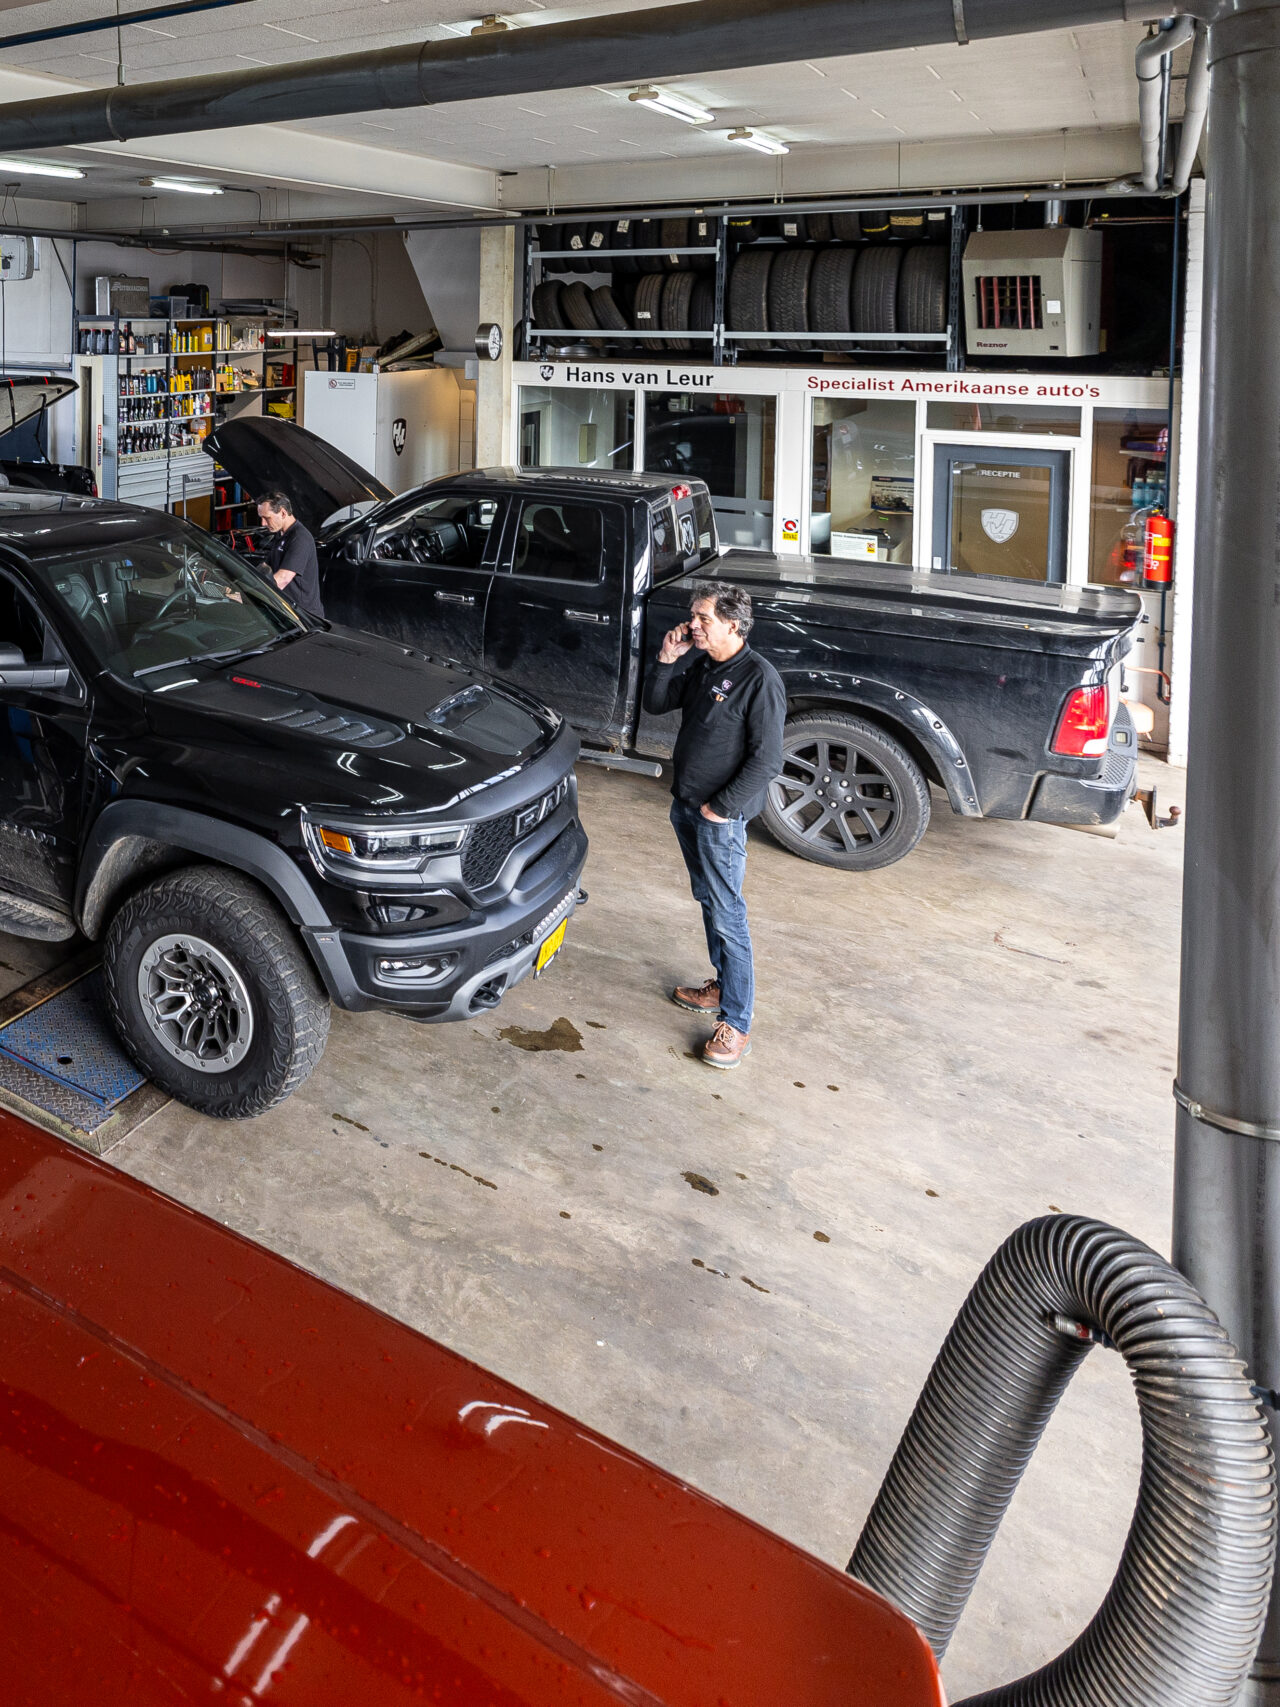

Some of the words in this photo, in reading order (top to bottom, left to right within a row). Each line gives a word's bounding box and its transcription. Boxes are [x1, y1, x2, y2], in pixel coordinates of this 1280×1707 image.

[566, 366, 615, 383] Hans
[622, 372, 658, 385] van
[666, 369, 714, 386] Leur
[807, 376, 894, 391] Specialist
[900, 379, 1029, 395] Amerikaanse
[1036, 384, 1100, 397] auto's
[980, 469, 1021, 478] RECEPTIE
